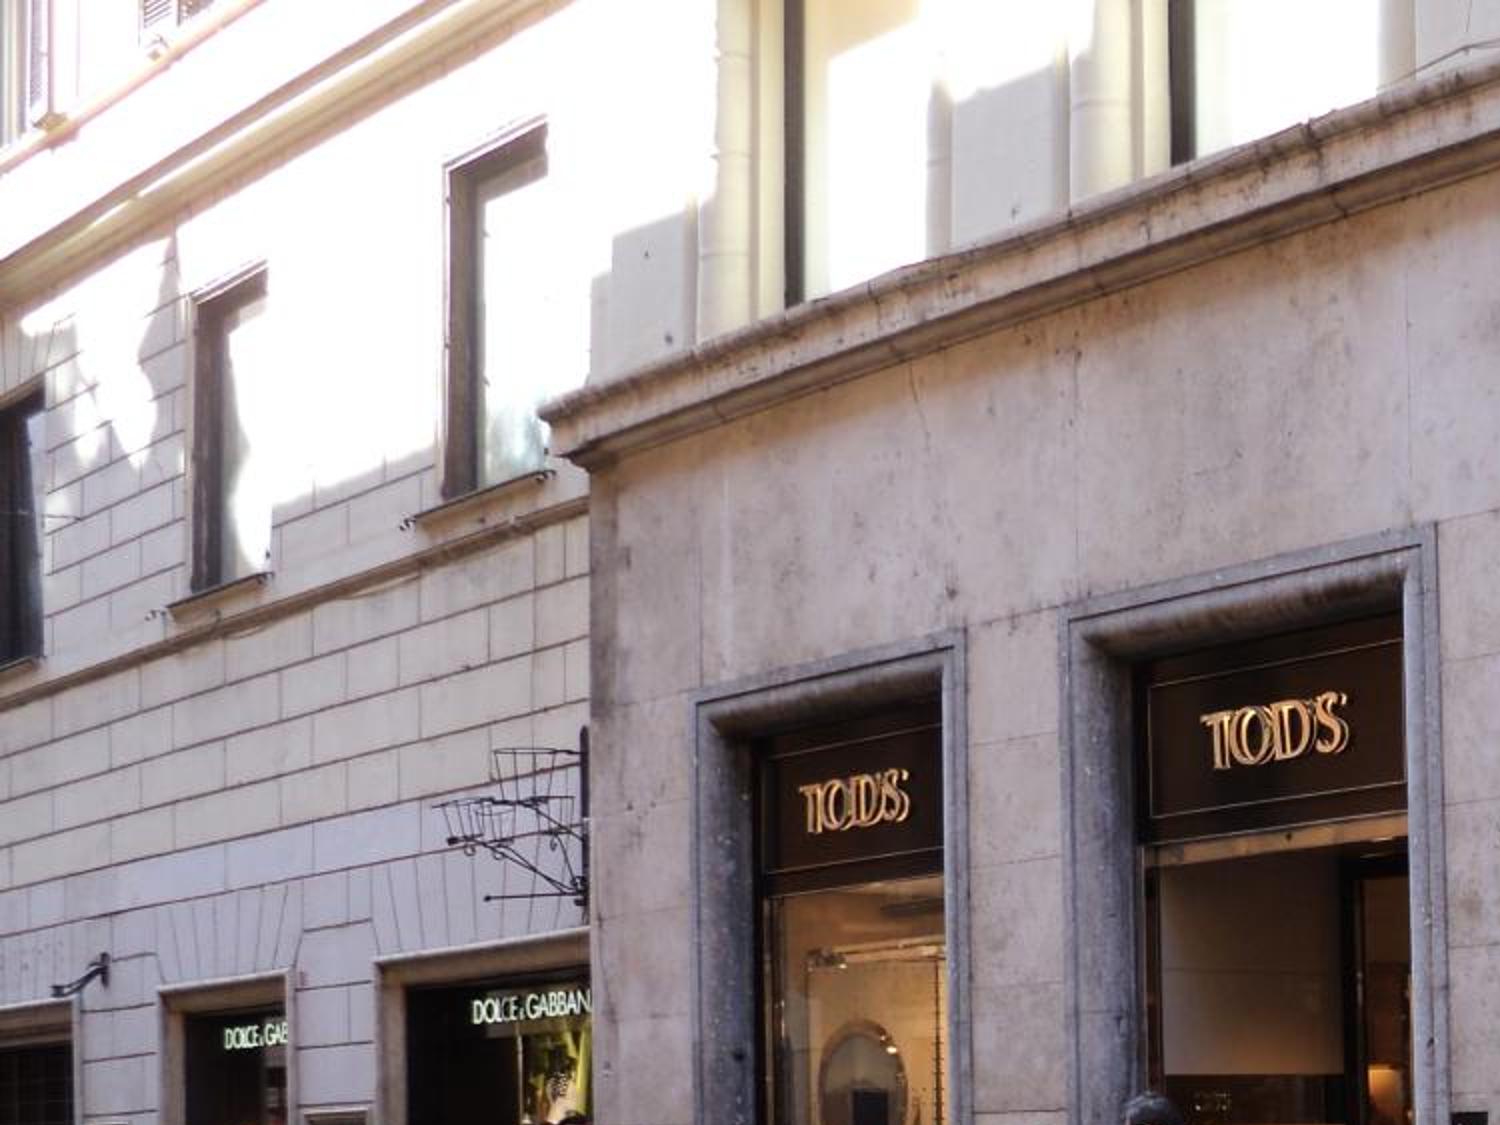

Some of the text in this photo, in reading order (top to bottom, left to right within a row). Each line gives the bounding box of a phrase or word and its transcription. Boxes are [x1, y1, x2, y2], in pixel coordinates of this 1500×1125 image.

[1200, 690, 1349, 769] TOD'S
[799, 768, 910, 834] TOD'S
[472, 996, 518, 1025] DOLCE
[224, 1025, 259, 1050] DOLCE
